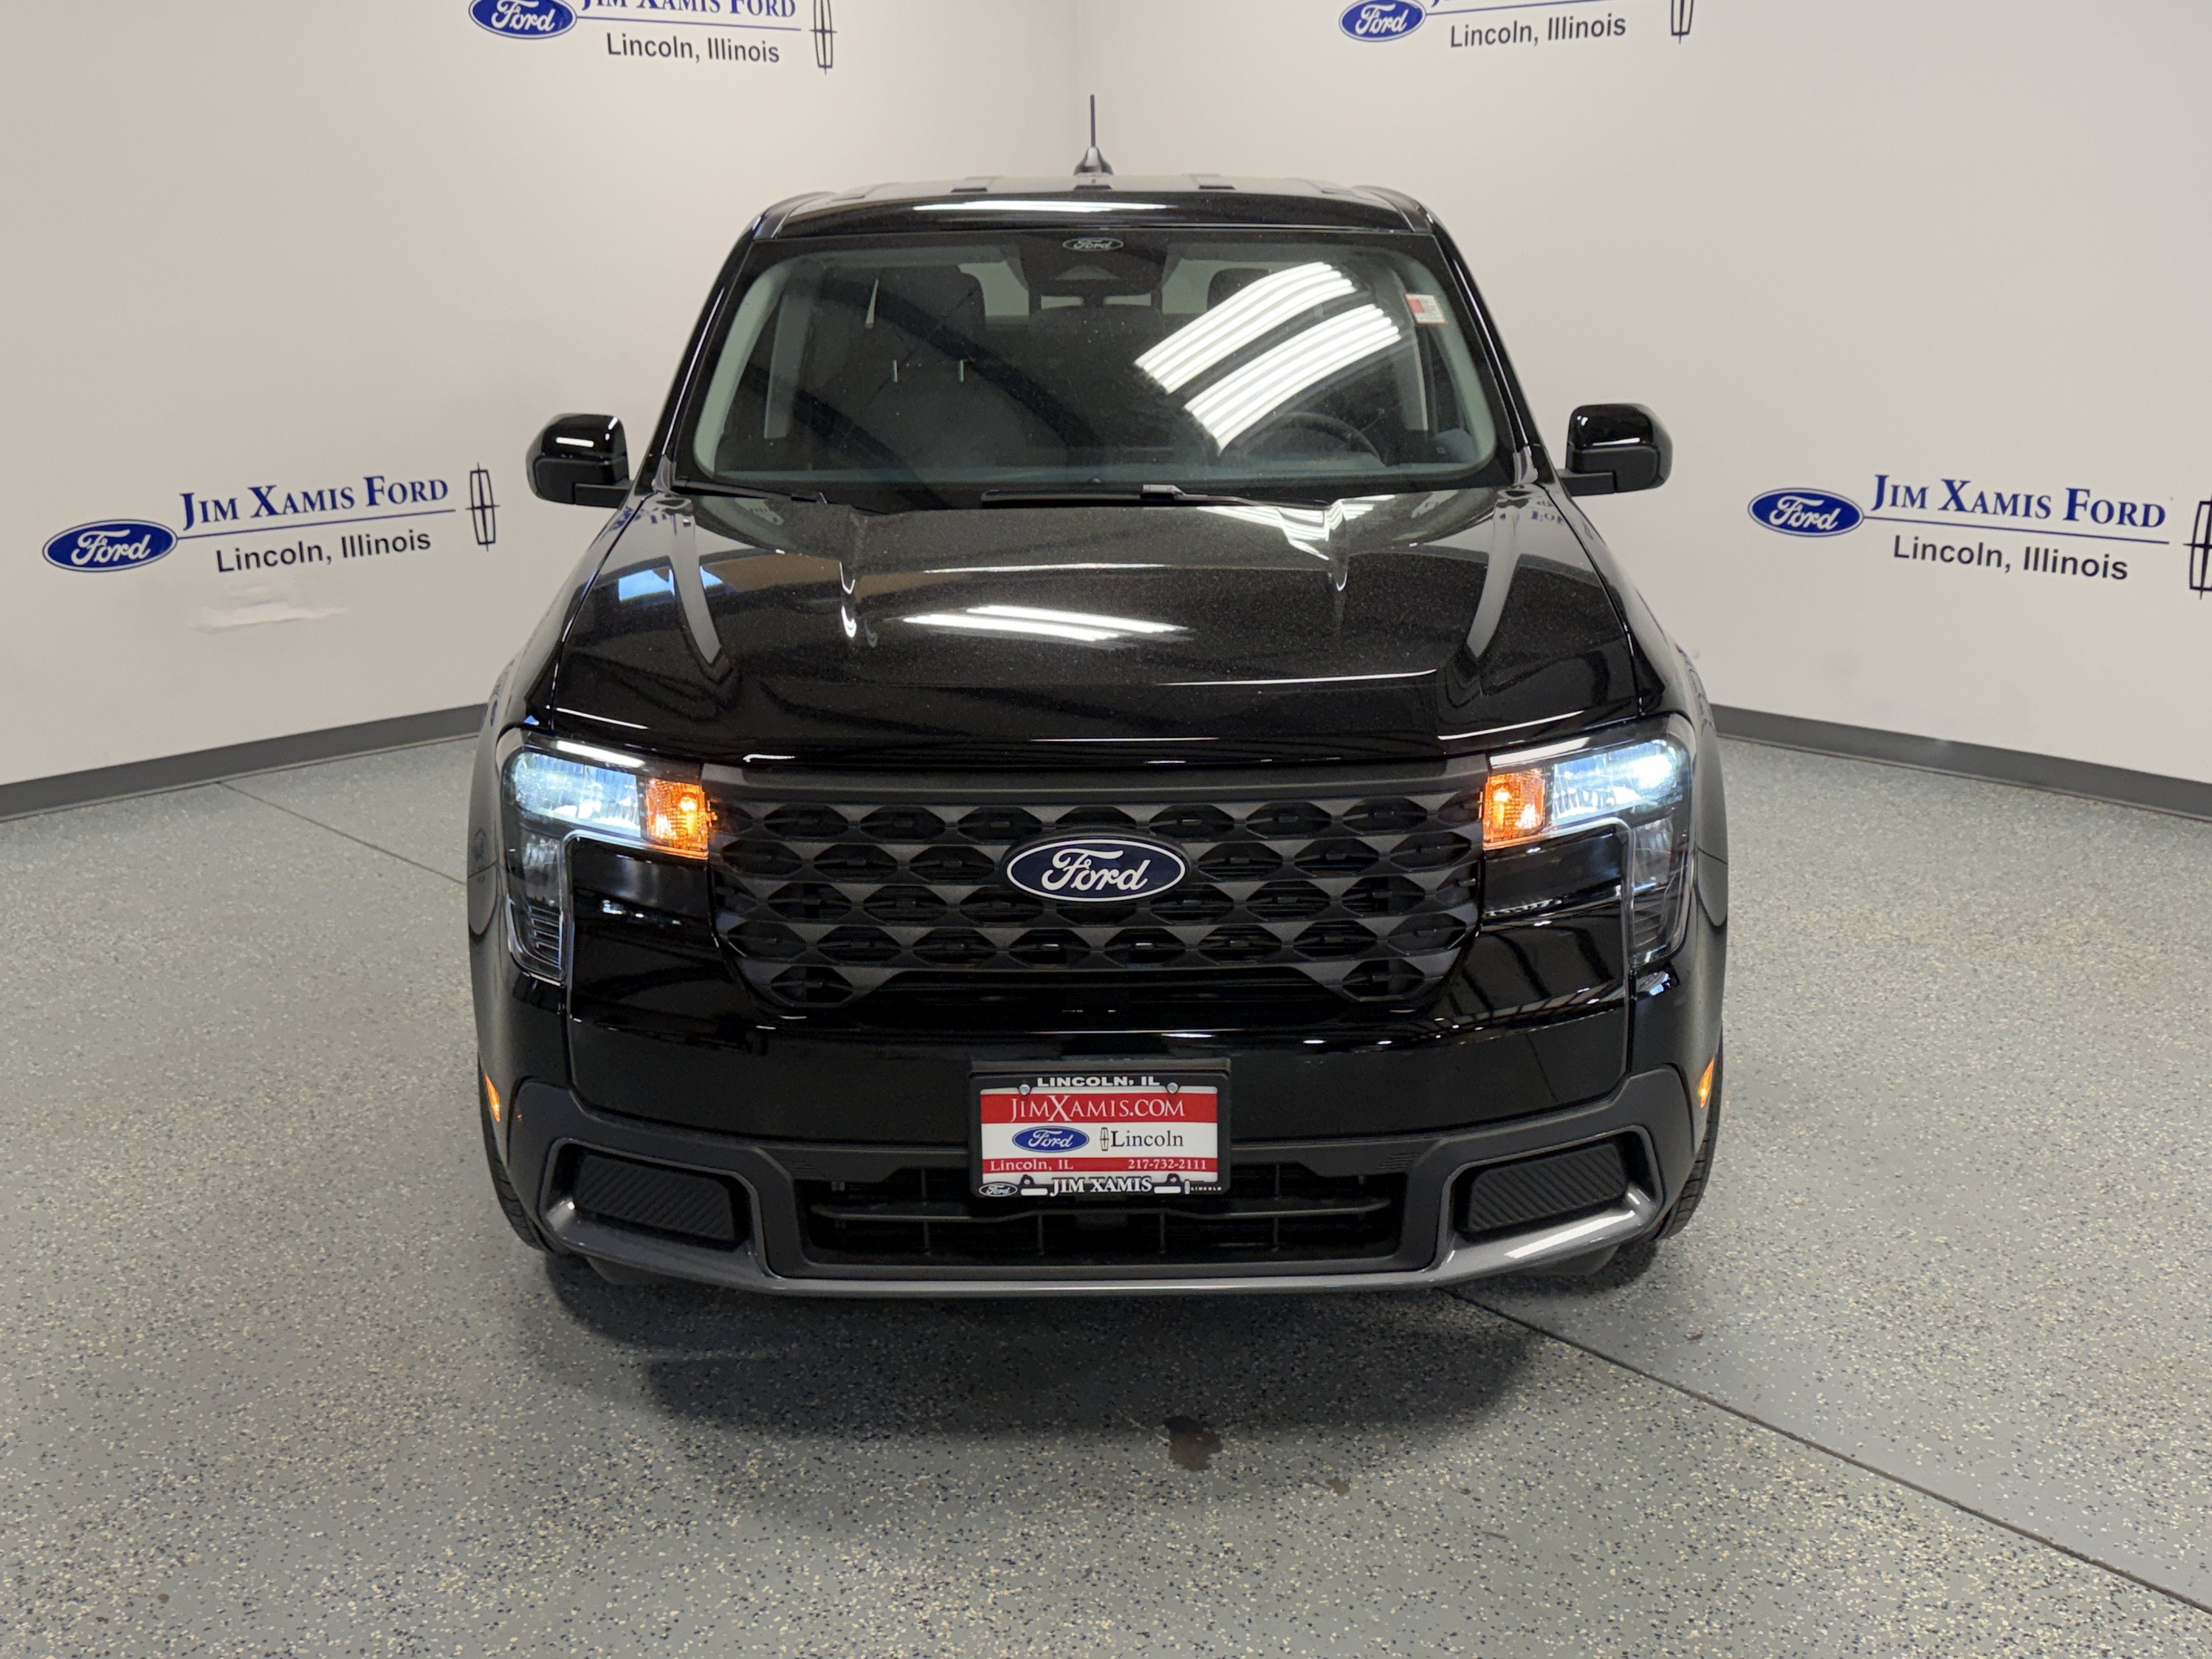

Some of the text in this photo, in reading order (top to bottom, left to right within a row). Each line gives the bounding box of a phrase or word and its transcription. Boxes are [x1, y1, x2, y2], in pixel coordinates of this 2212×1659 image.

[491, 0, 556, 31] Ford
[636, 0, 721, 13] MIS
[1355, 3, 1409, 35] Ford
[1450, 13, 1627, 48] Lincoln, Illinois
[606, 32, 780, 63] Lincoln, Illinois
[1074, 239, 1114, 250] Ford
[180, 475, 449, 531] JIM XAMIS FORD
[1768, 495, 1839, 531] Ford
[1871, 474, 2167, 529] JIM XAMIS FORD
[70, 528, 152, 566] Ford
[216, 529, 432, 573] Lincoln, Illinois
[1894, 534, 2129, 580] Lincoln, Illinois
[1041, 848, 1151, 891] Ford
[1037, 1076, 1160, 1087] LINCOLN, IL
[1010, 1095, 1185, 1122] JIMXAMIS.COM
[1027, 1130, 1073, 1148] Ford
[1110, 1130, 1184, 1148] Lincoln
[990, 1159, 1074, 1172] Lincoln, IL
[1127, 1159, 1207, 1170] 217-732-2111
[986, 1184, 1011, 1195] Ford
[1049, 1177, 1153, 1197] JIM XAMIS
